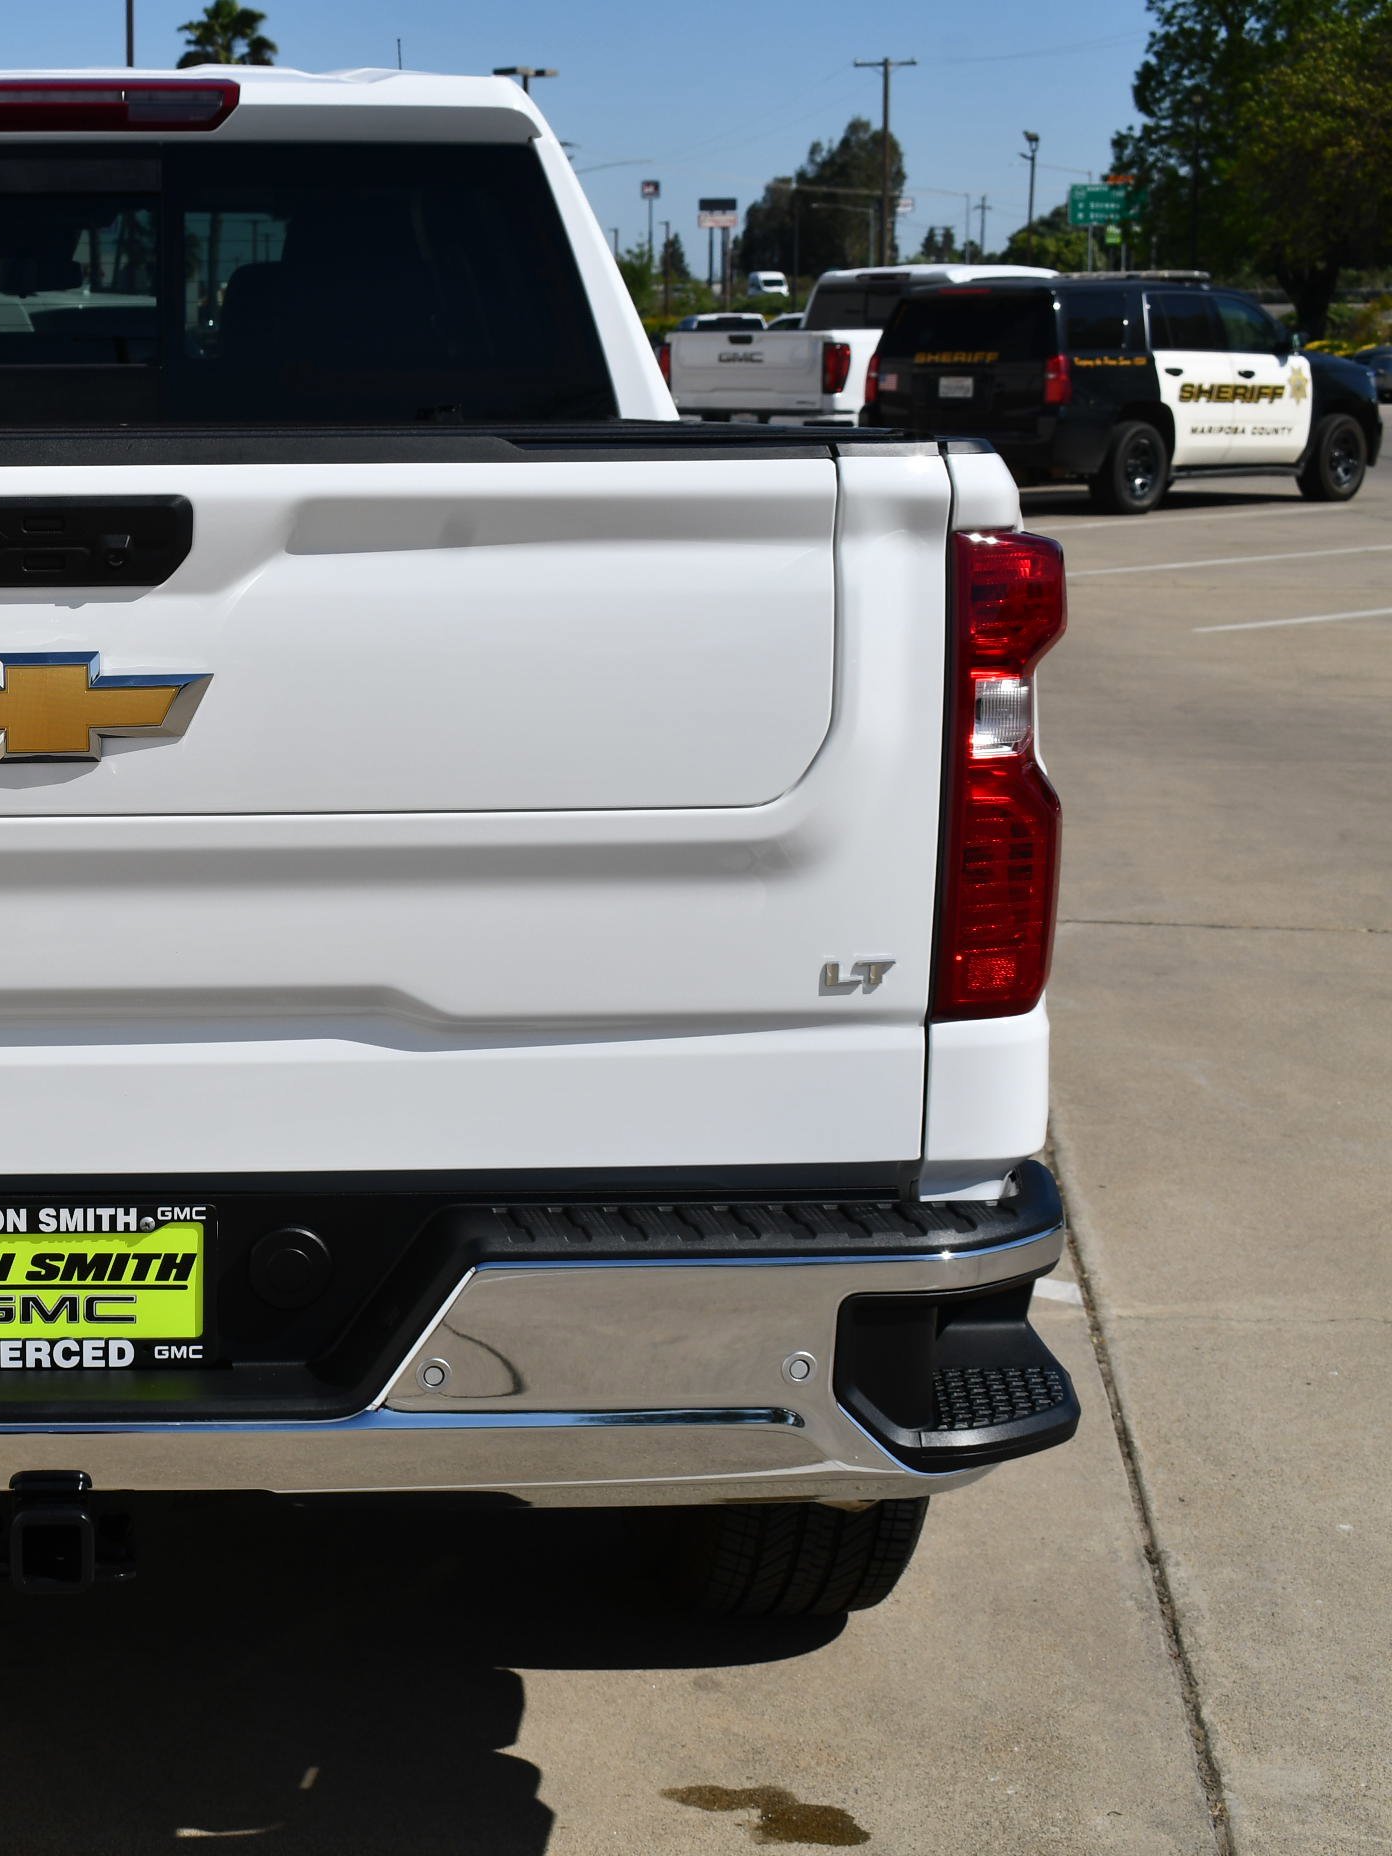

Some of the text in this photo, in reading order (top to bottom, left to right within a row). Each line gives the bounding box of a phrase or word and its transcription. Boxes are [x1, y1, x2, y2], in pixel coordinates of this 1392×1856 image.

[717, 352, 764, 363] GMC
[913, 351, 999, 364] SHERIFF
[1179, 383, 1285, 404] SHERIFF
[1251, 426, 1294, 436] COUNTY
[821, 959, 896, 990] LT
[38, 1207, 138, 1232] SMITH
[157, 1206, 207, 1221] GMC
[25, 1252, 198, 1283] SMITH
[154, 1345, 204, 1360] GMC
